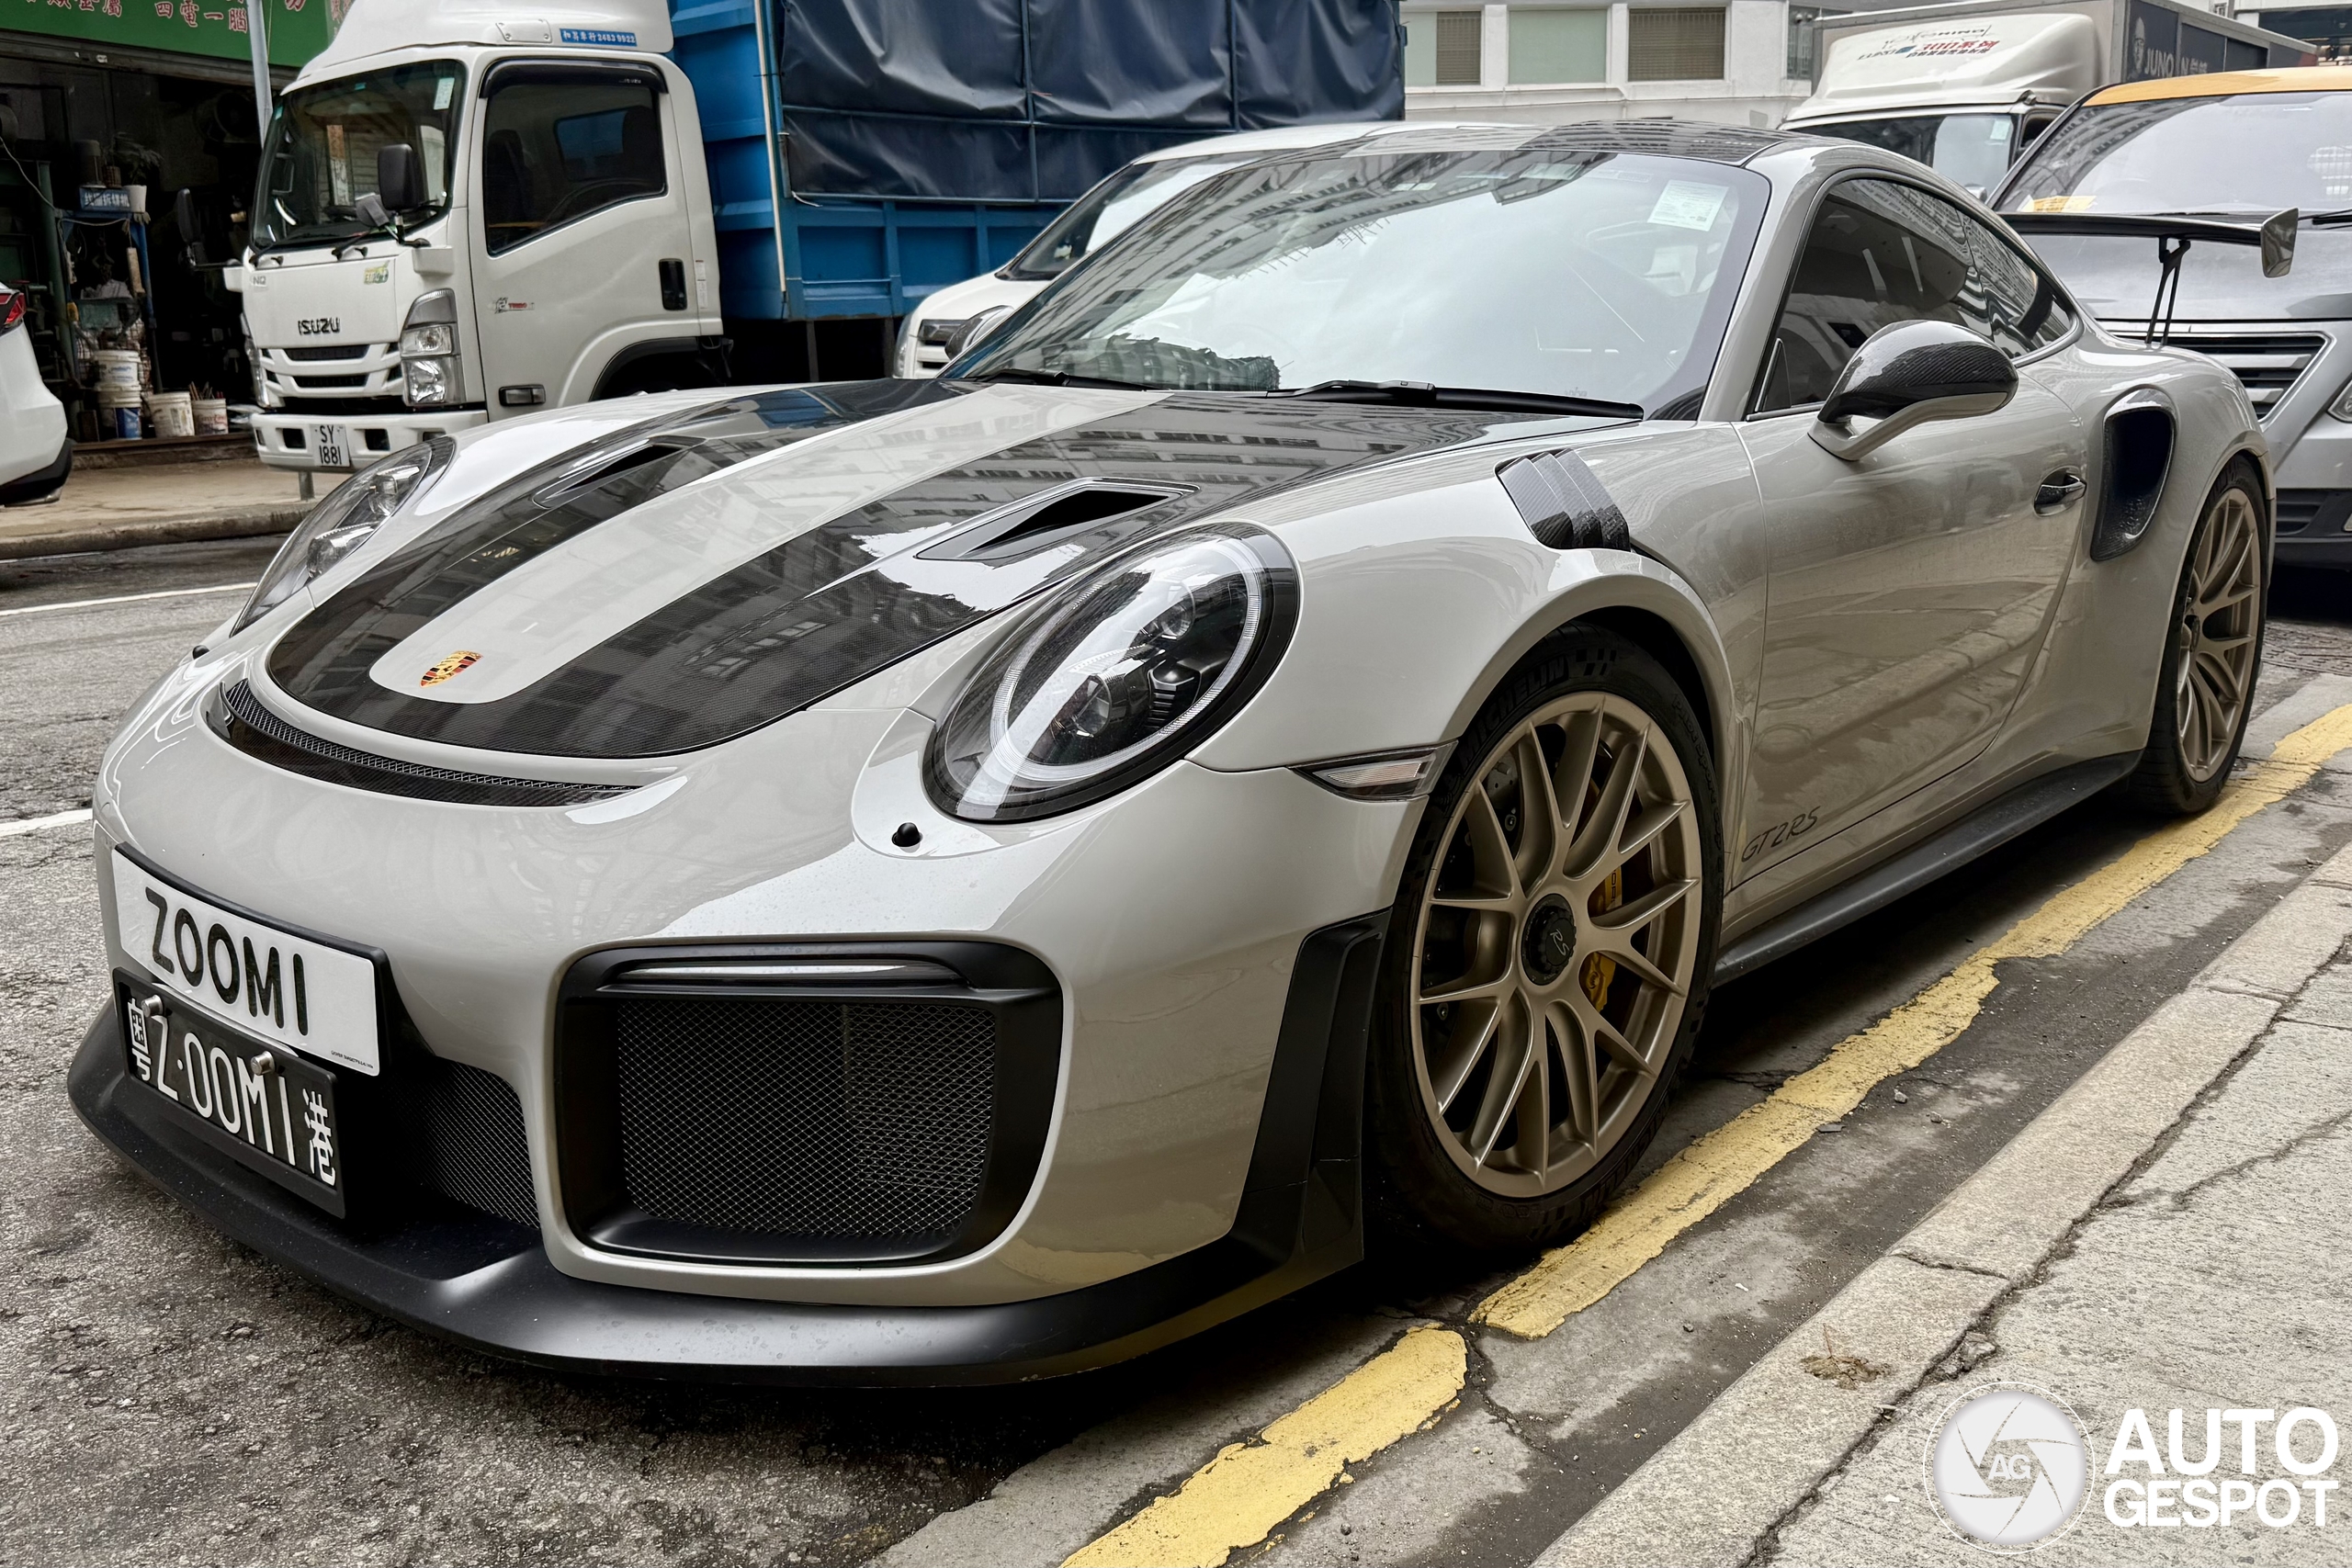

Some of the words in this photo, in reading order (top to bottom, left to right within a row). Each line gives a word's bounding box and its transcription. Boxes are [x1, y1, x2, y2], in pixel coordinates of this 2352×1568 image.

[298, 317, 340, 335] ISUZU
[319, 424, 334, 444] SY
[319, 445, 342, 465] 1881
